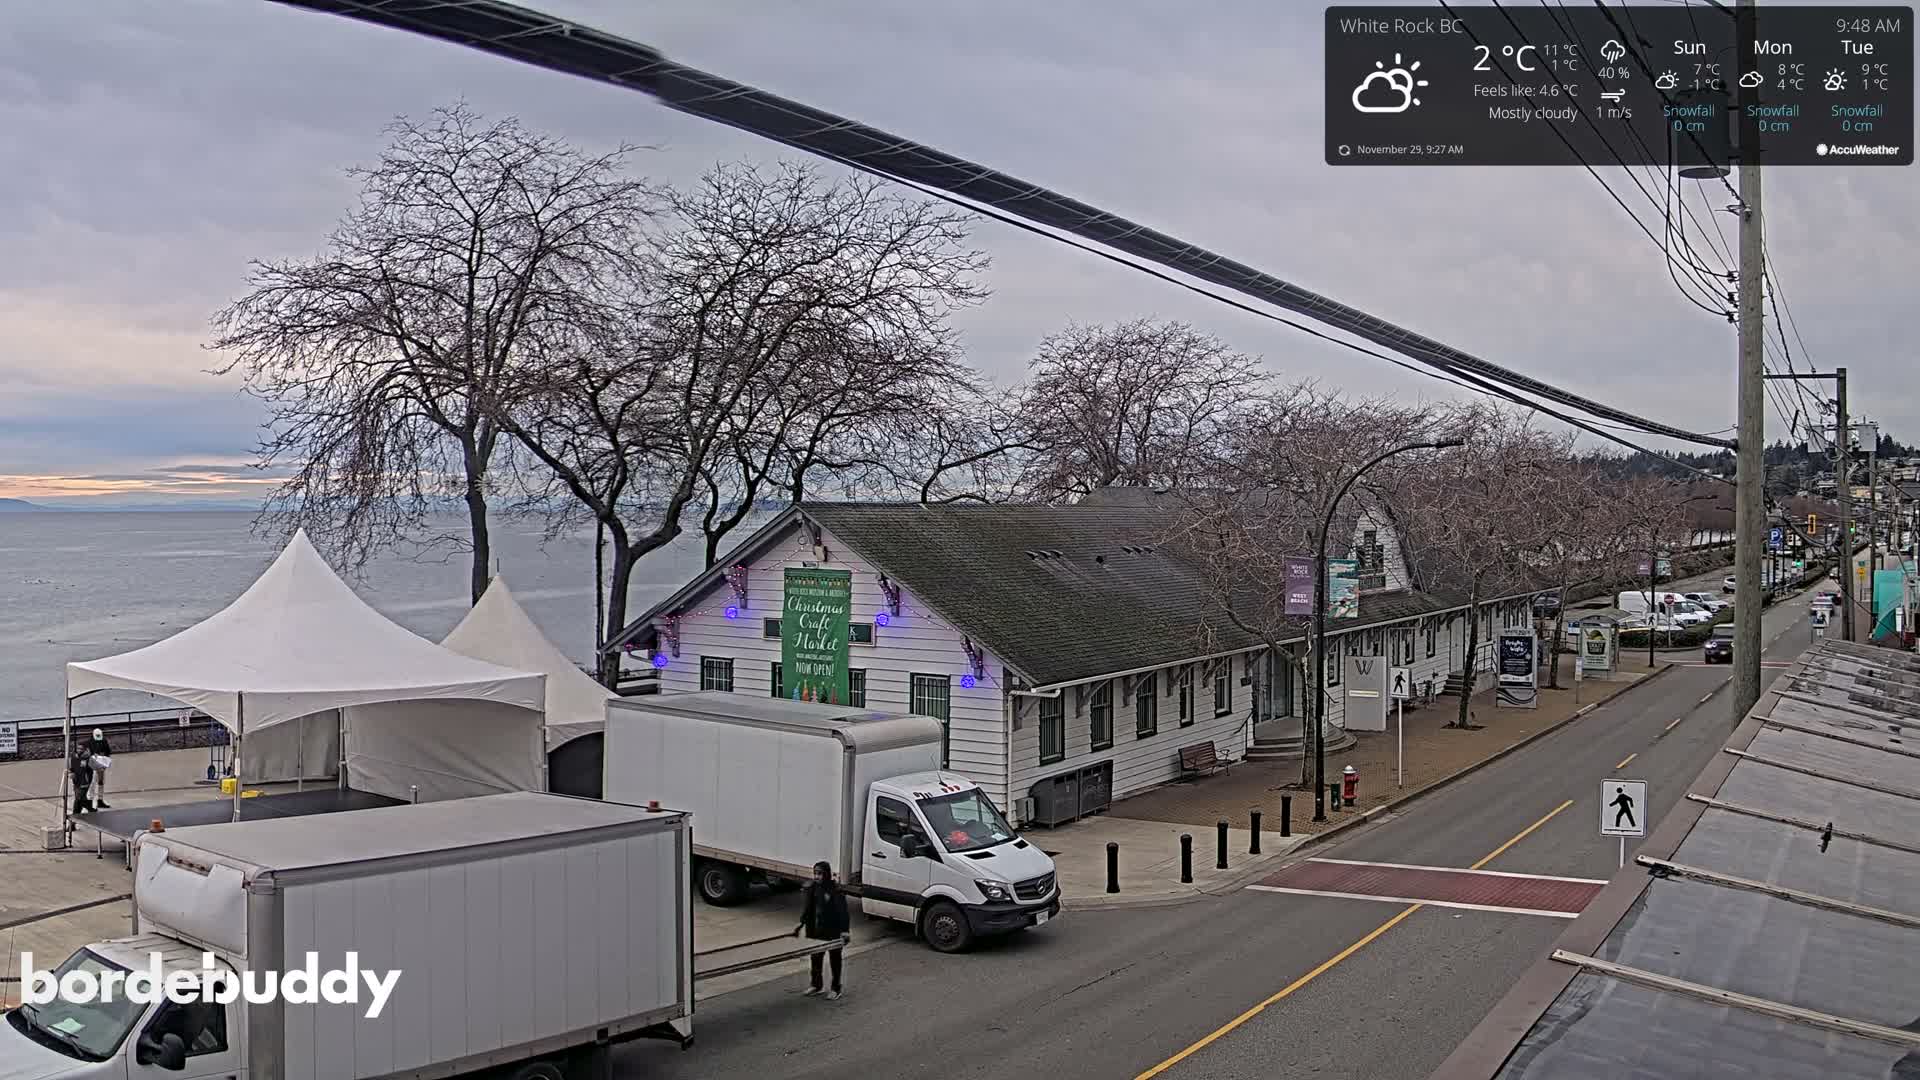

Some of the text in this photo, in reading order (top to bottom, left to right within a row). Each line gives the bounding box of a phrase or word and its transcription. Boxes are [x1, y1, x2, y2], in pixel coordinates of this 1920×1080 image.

[1771, 531, 1778, 540] P
[788, 596, 844, 614] Christmas
[799, 613, 831, 639] Craft
[792, 632, 840, 651] Market
[796, 662, 834, 677] NOW OPEN!
